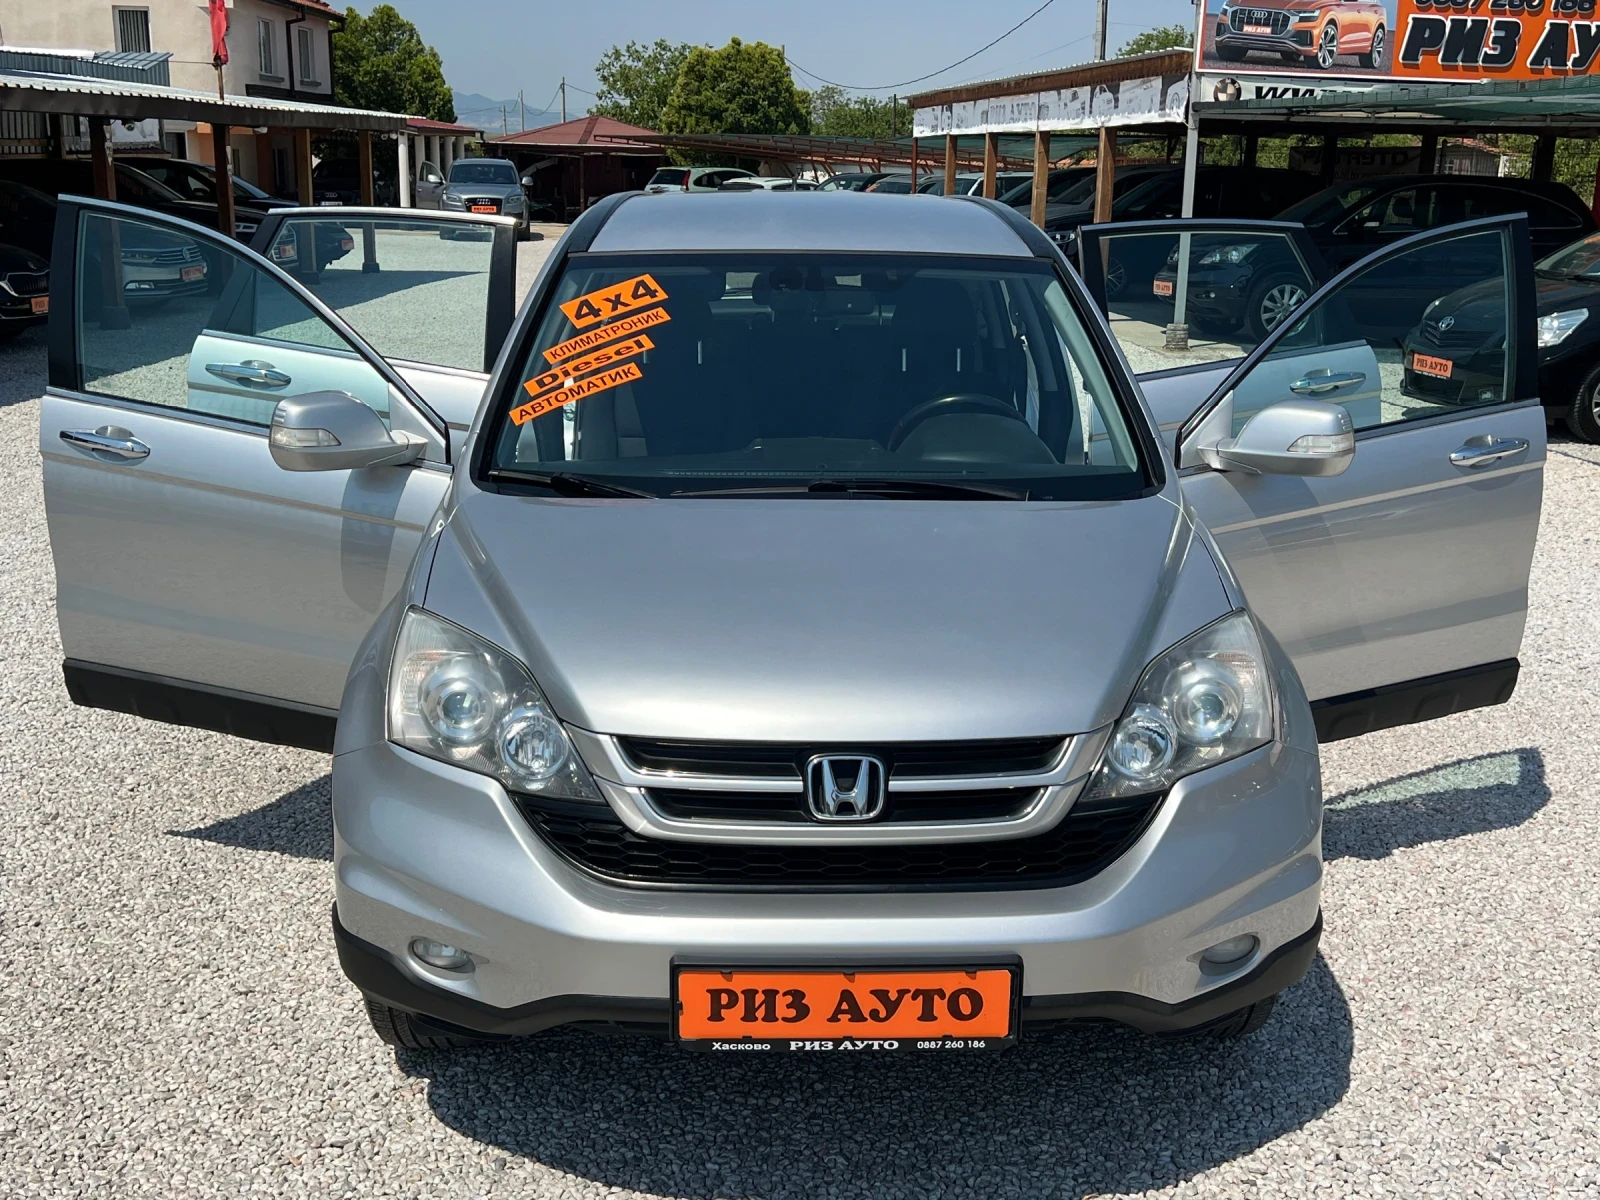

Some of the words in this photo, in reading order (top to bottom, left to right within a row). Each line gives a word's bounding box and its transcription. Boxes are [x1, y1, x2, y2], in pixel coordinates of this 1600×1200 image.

[1399, 14, 1522, 68] РИЗ
[575, 279, 659, 320] 4x4
[550, 310, 664, 360] КЛИМАТРОНИК
[535, 339, 645, 389] Diesel
[1416, 357, 1428, 368] РИЗ
[1429, 360, 1448, 373] АУТО
[518, 366, 636, 420] АВТОМАТИК
[706, 988, 811, 1023] РИЗ
[826, 987, 984, 1023] АУТО
[712, 1042, 771, 1051] Хасково
[789, 1041, 834, 1051] РИЗ
[838, 1040, 899, 1050] АУТО
[917, 1041, 942, 1049] 0887
[945, 1040, 964, 1048] 260
[968, 1040, 986, 1048] 186
